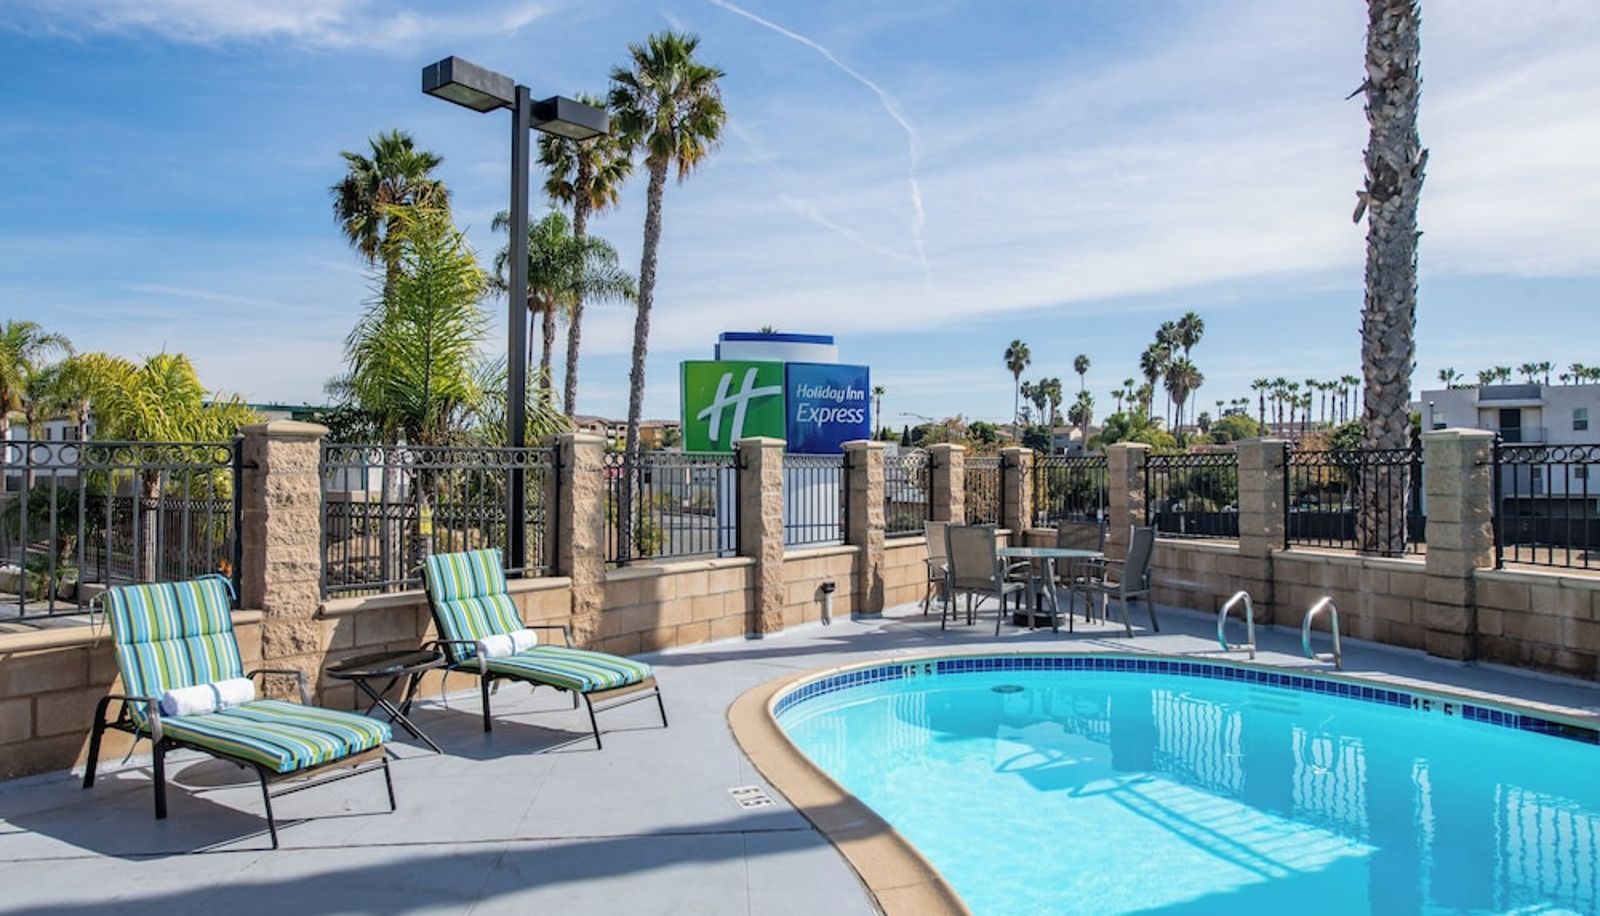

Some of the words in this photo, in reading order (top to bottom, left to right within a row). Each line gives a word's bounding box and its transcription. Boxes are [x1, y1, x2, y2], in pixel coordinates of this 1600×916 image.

[796, 383, 845, 403] Holiday
[846, 385, 864, 399] Inn
[796, 403, 864, 427] Express
